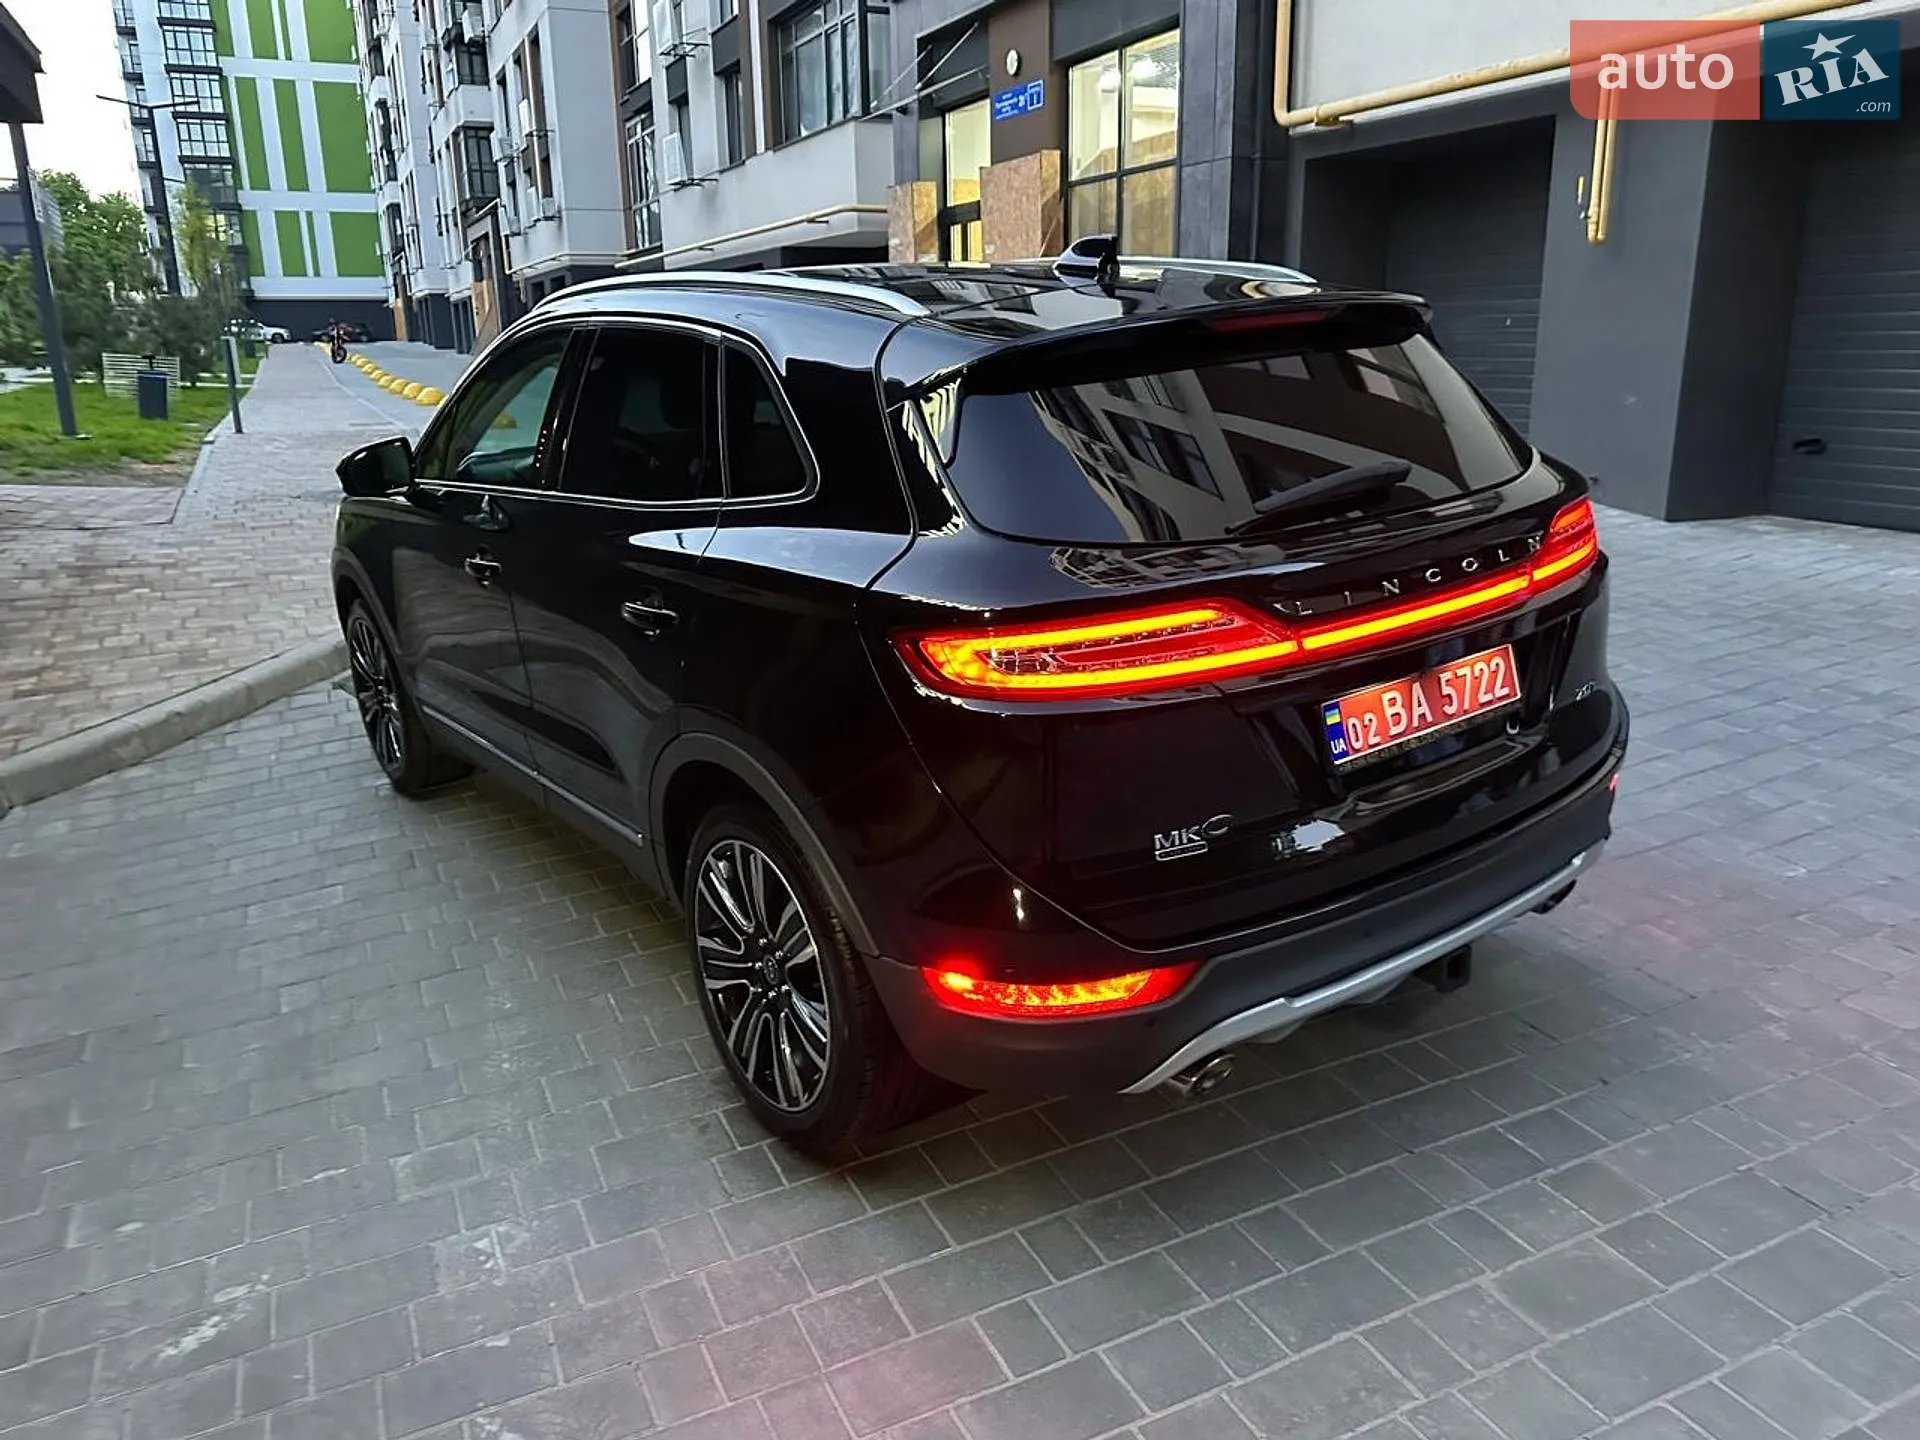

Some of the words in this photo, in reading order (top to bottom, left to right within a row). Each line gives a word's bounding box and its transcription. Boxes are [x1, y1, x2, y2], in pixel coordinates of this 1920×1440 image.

[1296, 535, 1541, 616] LINCOLN
[1347, 711, 1381, 750] 02
[1381, 682, 1433, 737] BA
[1438, 656, 1510, 716] 5722
[1331, 738, 1347, 754] UA
[1154, 813, 1233, 850] MKC
